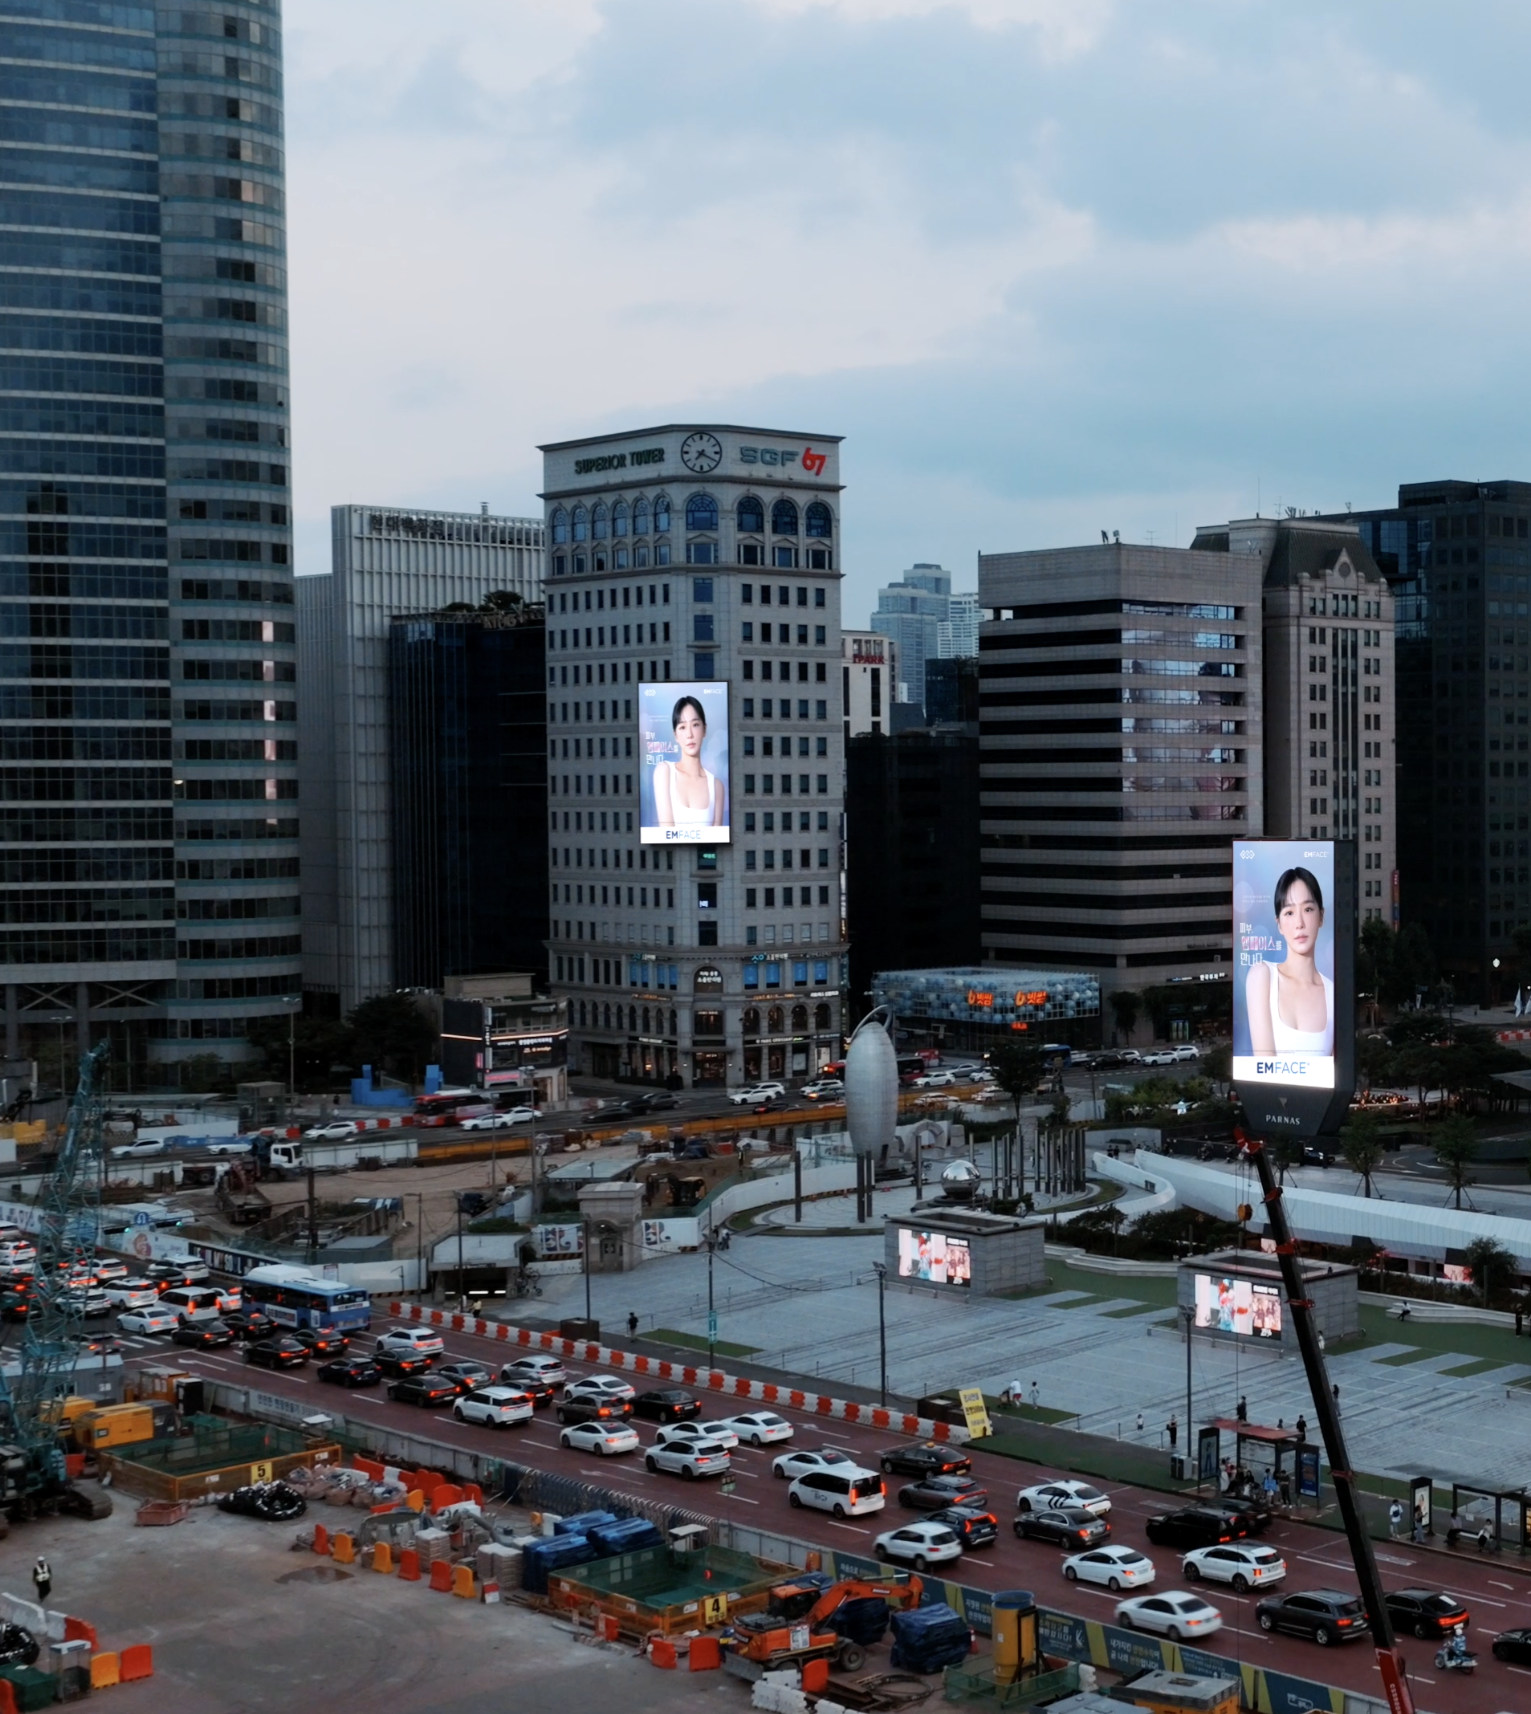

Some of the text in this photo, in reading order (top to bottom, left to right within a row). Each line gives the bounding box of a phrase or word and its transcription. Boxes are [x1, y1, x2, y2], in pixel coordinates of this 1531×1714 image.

[574, 447, 665, 475] SUPERIOR TOWER
[1241, 936, 1282, 951] 엠페이스를
[1240, 952, 1263, 967] 만나다
[1265, 1114, 1300, 1126] PARNAS
[257, 1464, 266, 1478] 5
[712, 1598, 721, 1613] 4
